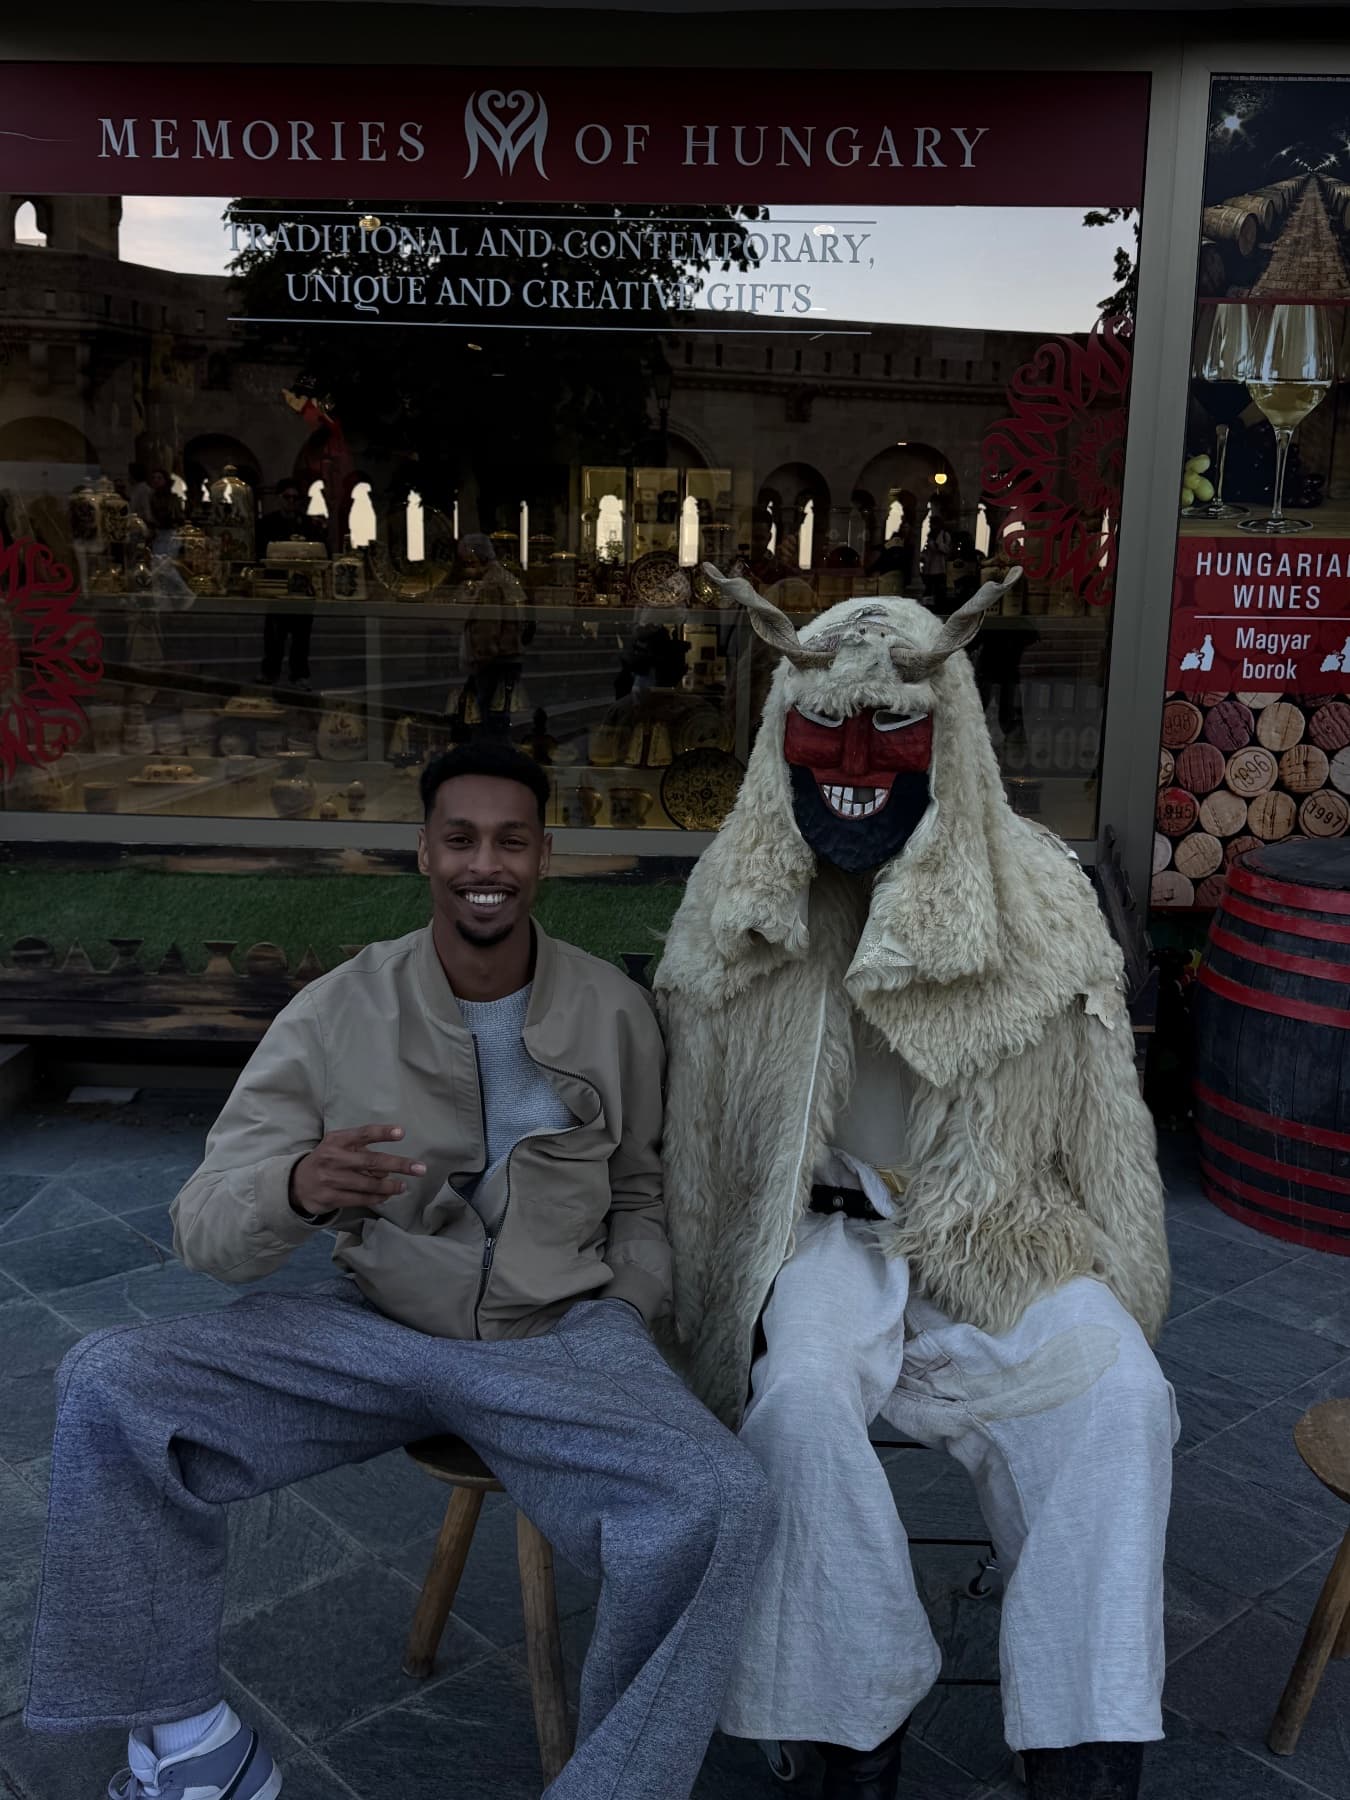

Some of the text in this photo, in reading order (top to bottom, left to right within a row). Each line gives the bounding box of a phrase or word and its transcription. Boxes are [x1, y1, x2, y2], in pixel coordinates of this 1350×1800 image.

[97, 118, 992, 168] MEMORIES OF HUNGARY
[224, 222, 874, 269] TRADITIONAL AND CONTEMPORARY,
[286, 272, 812, 316] UNIQUE AND CREATIVE GIFTS
[1196, 552, 1350, 578] HUNGARIA
[1233, 584, 1321, 609] WINES
[1235, 627, 1312, 655] Magyar
[1242, 657, 1297, 680] borok
[1306, 802, 1343, 829] 1997
